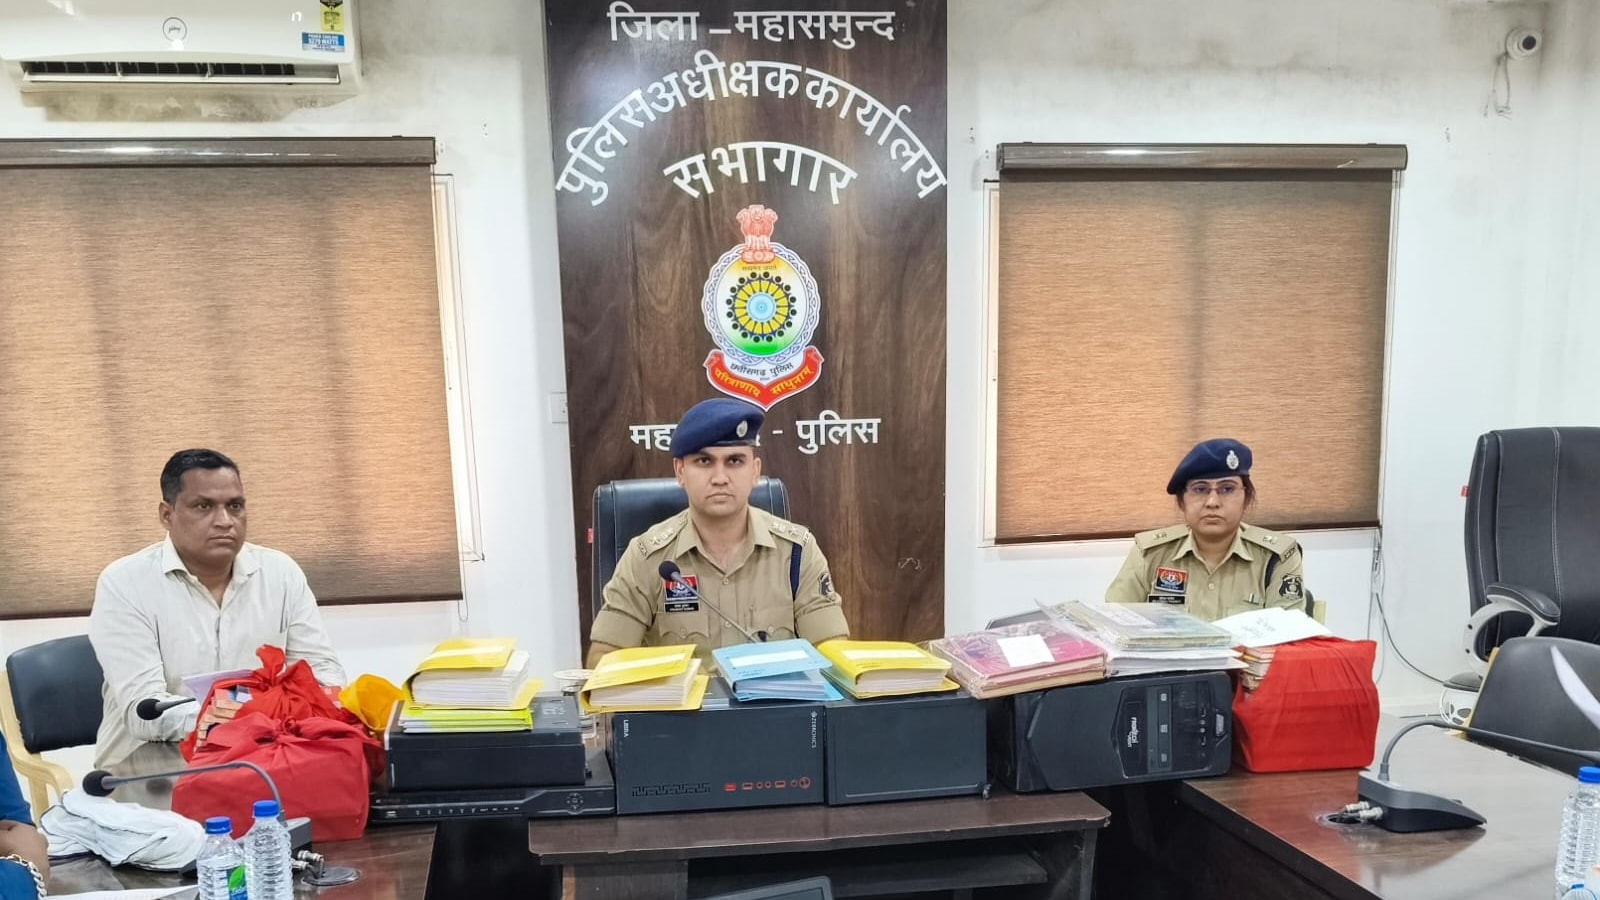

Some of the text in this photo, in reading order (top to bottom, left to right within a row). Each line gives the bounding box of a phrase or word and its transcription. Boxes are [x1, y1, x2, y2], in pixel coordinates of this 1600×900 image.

[606, 1, 700, 41] जिला
[663, 141, 858, 204] सभागार
[796, 409, 881, 455] पुलिस
